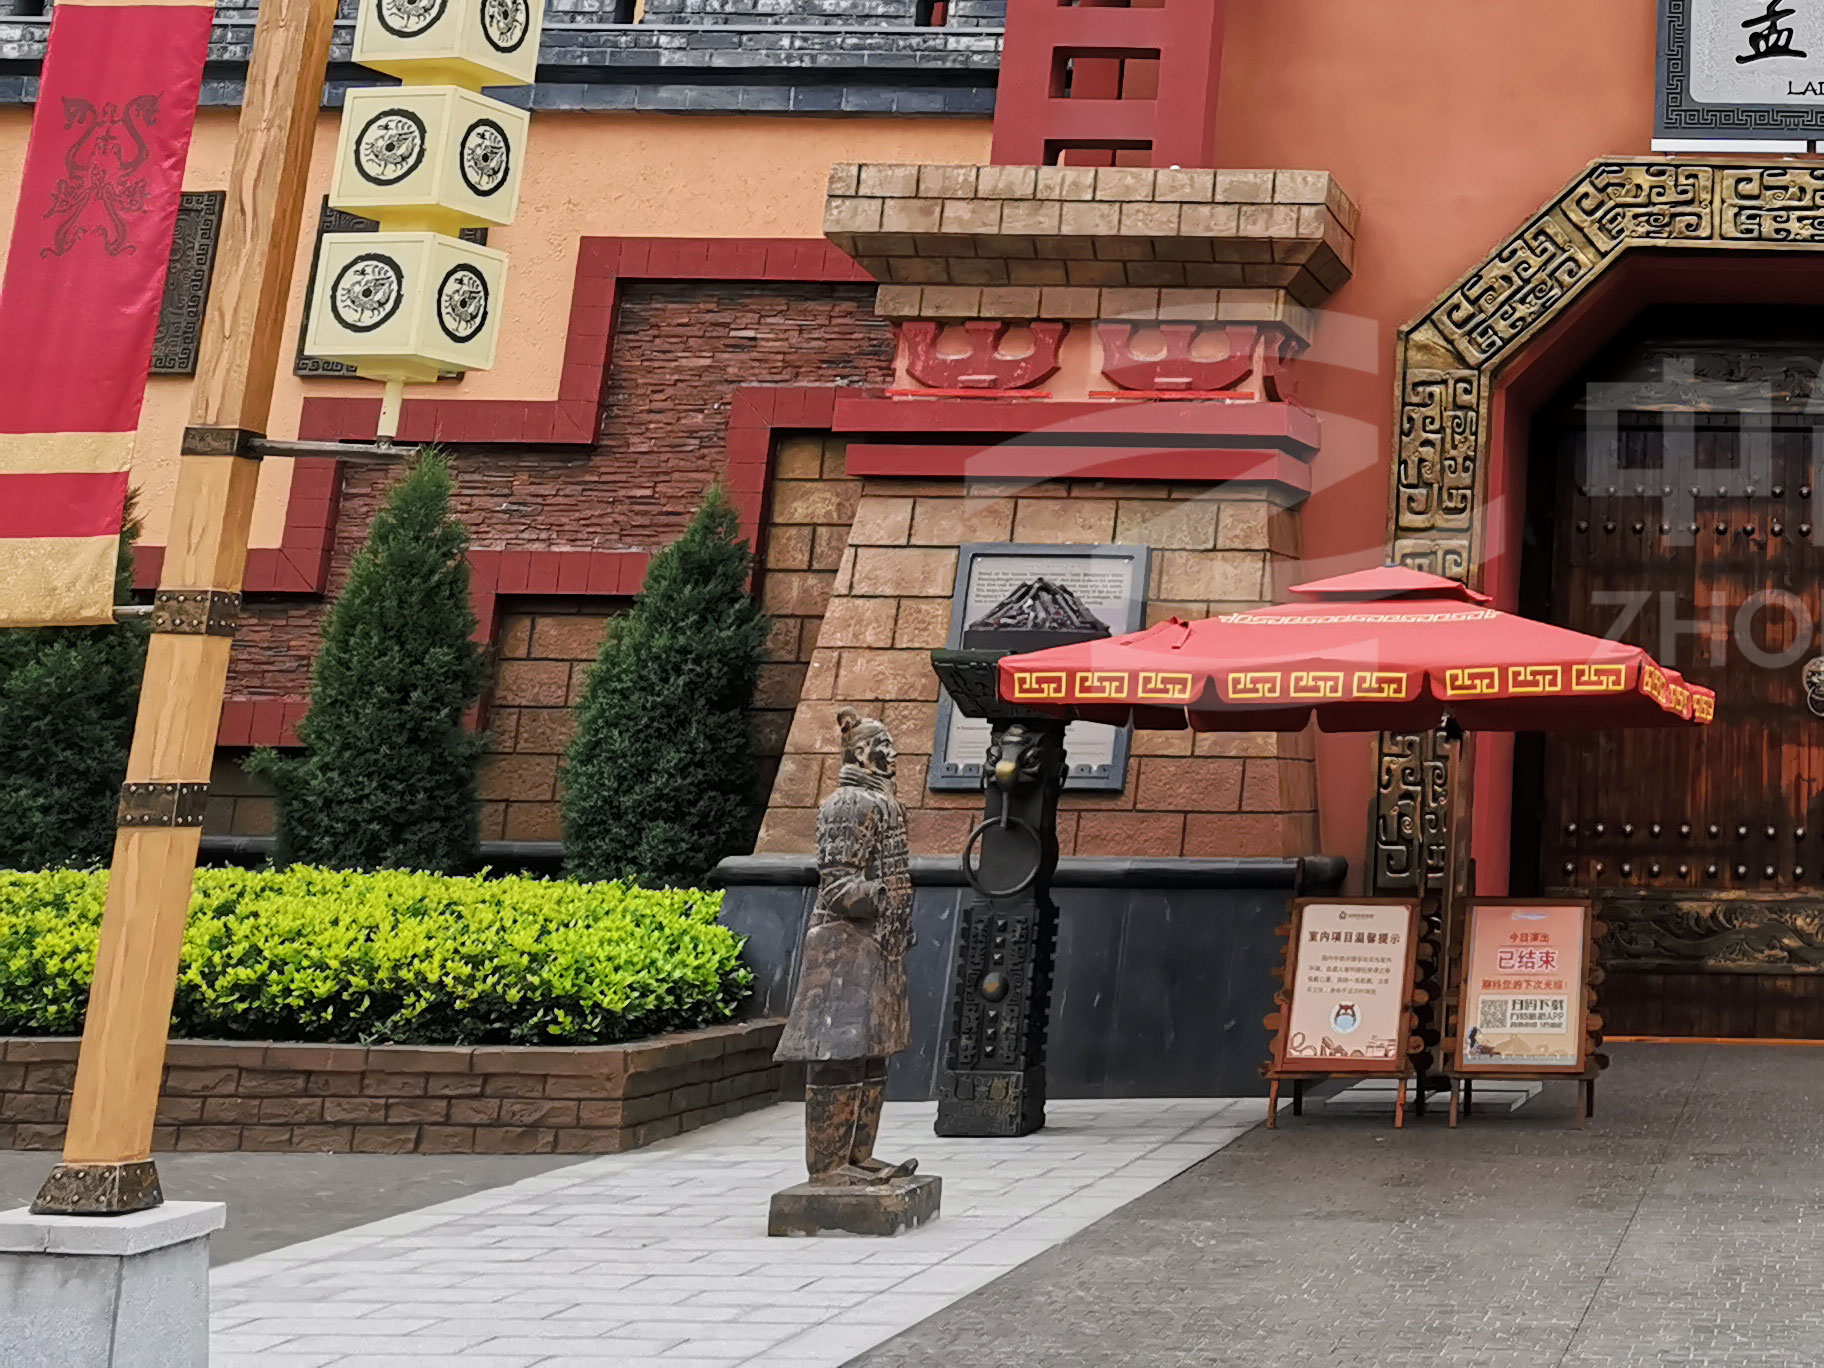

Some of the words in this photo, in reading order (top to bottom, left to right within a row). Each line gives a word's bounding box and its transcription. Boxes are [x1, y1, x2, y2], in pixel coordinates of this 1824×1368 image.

[1308, 930, 1401, 945] 室内项目温馨提示
[1508, 931, 1551, 944] 今日演出
[1497, 949, 1557, 971] 已结束
[1511, 998, 1565, 1011] 扫码下载
